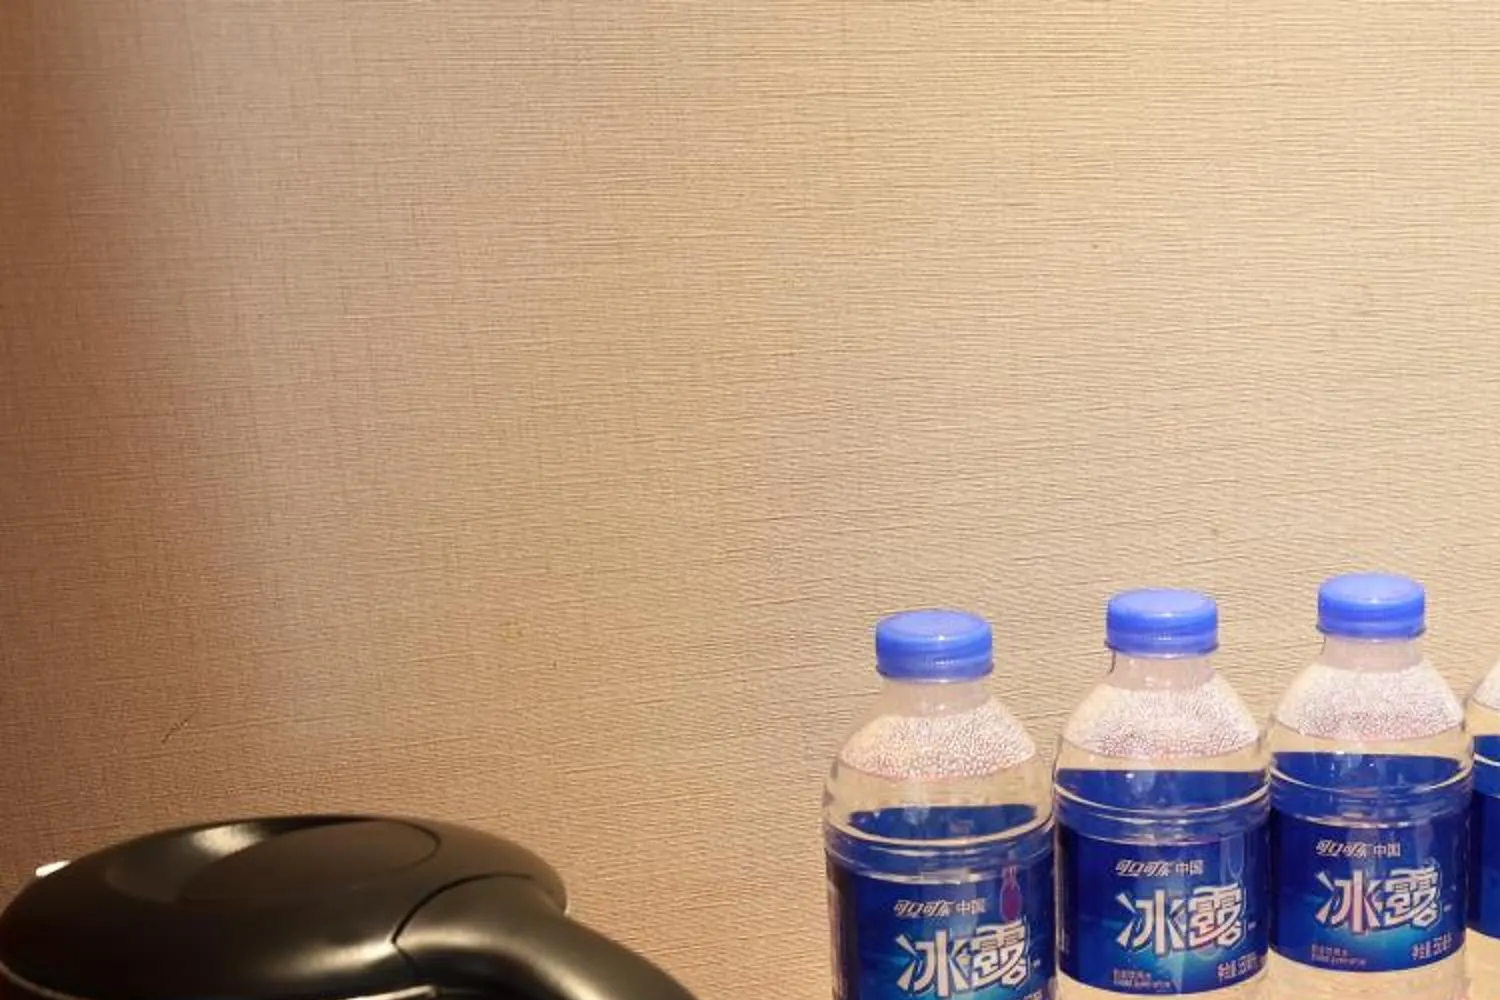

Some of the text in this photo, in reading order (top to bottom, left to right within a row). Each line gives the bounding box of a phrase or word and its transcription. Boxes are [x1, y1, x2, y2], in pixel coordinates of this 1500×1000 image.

[1116, 883, 1245, 956] 冰露
[1315, 866, 1441, 934] 冰露
[896, 920, 1028, 998] 冰露
